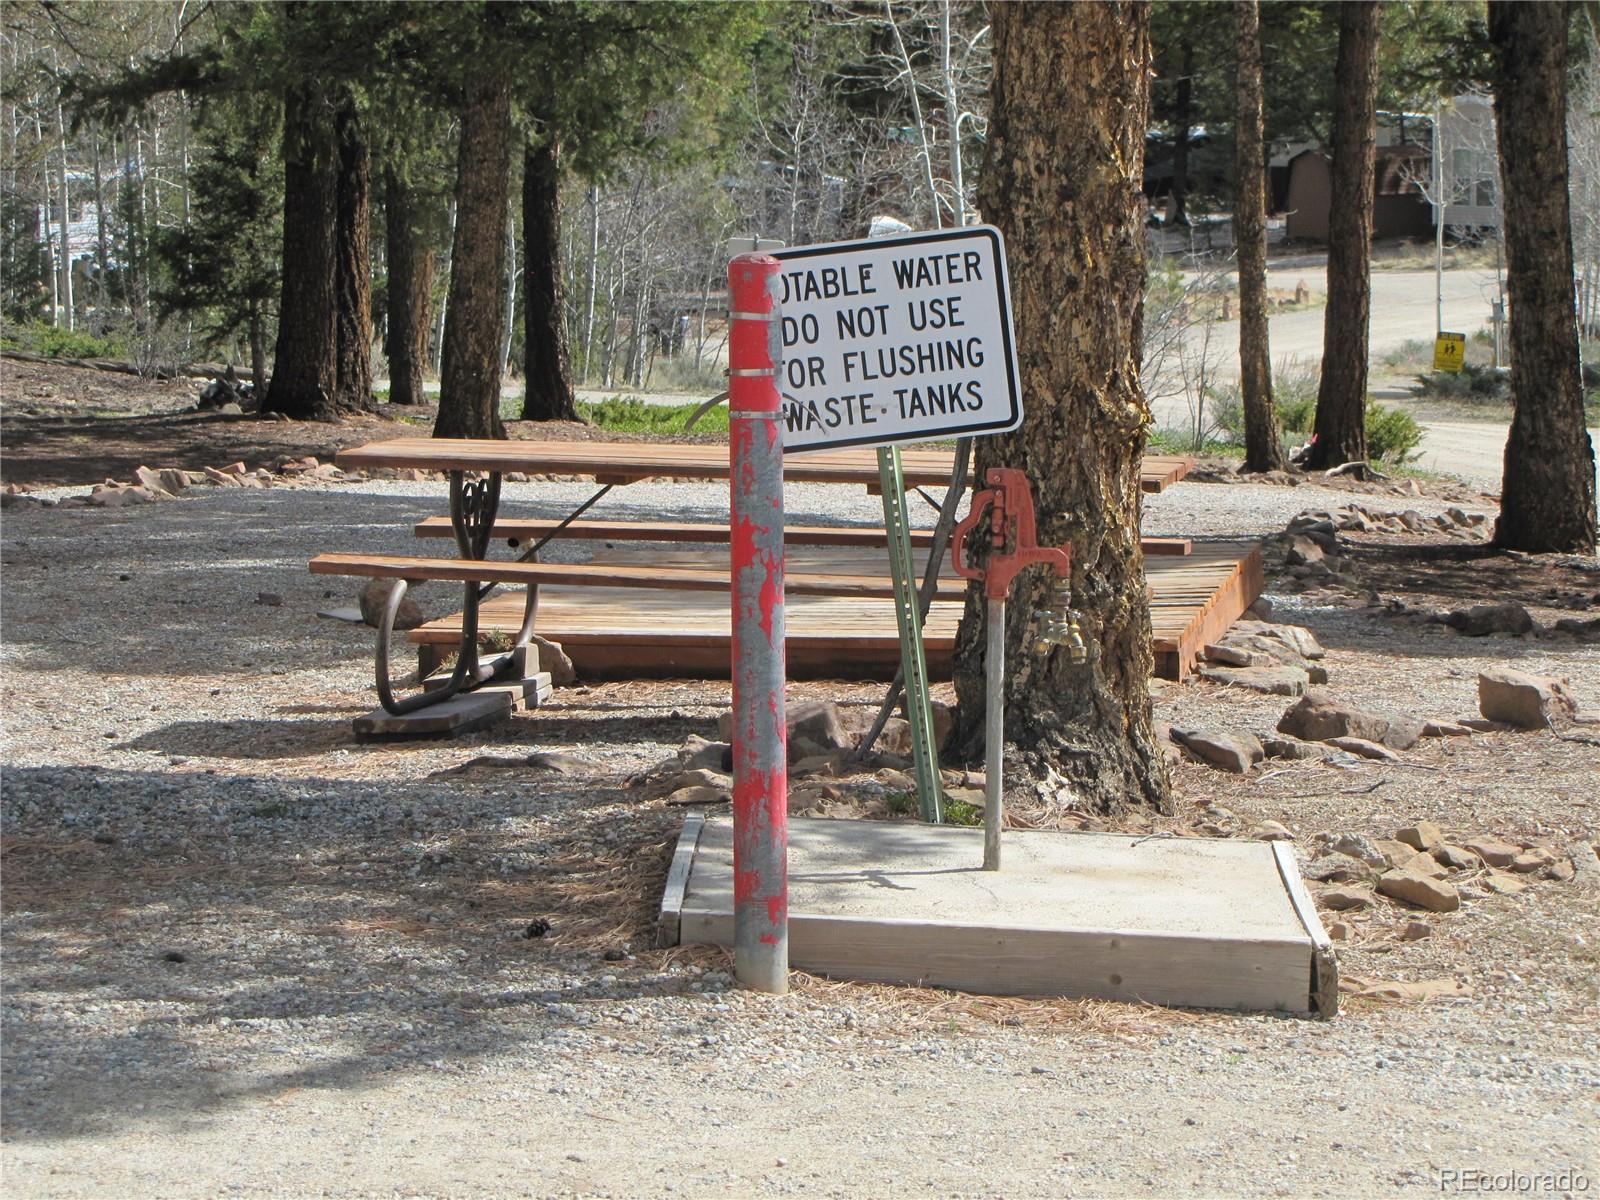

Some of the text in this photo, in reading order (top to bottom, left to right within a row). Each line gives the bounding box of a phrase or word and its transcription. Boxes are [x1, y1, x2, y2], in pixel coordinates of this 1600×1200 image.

[893, 251, 982, 290] WATER
[781, 296, 964, 347] DO NOT USE
[782, 337, 984, 389] OR FLUSHING
[782, 381, 983, 432] WASTE TANKS
